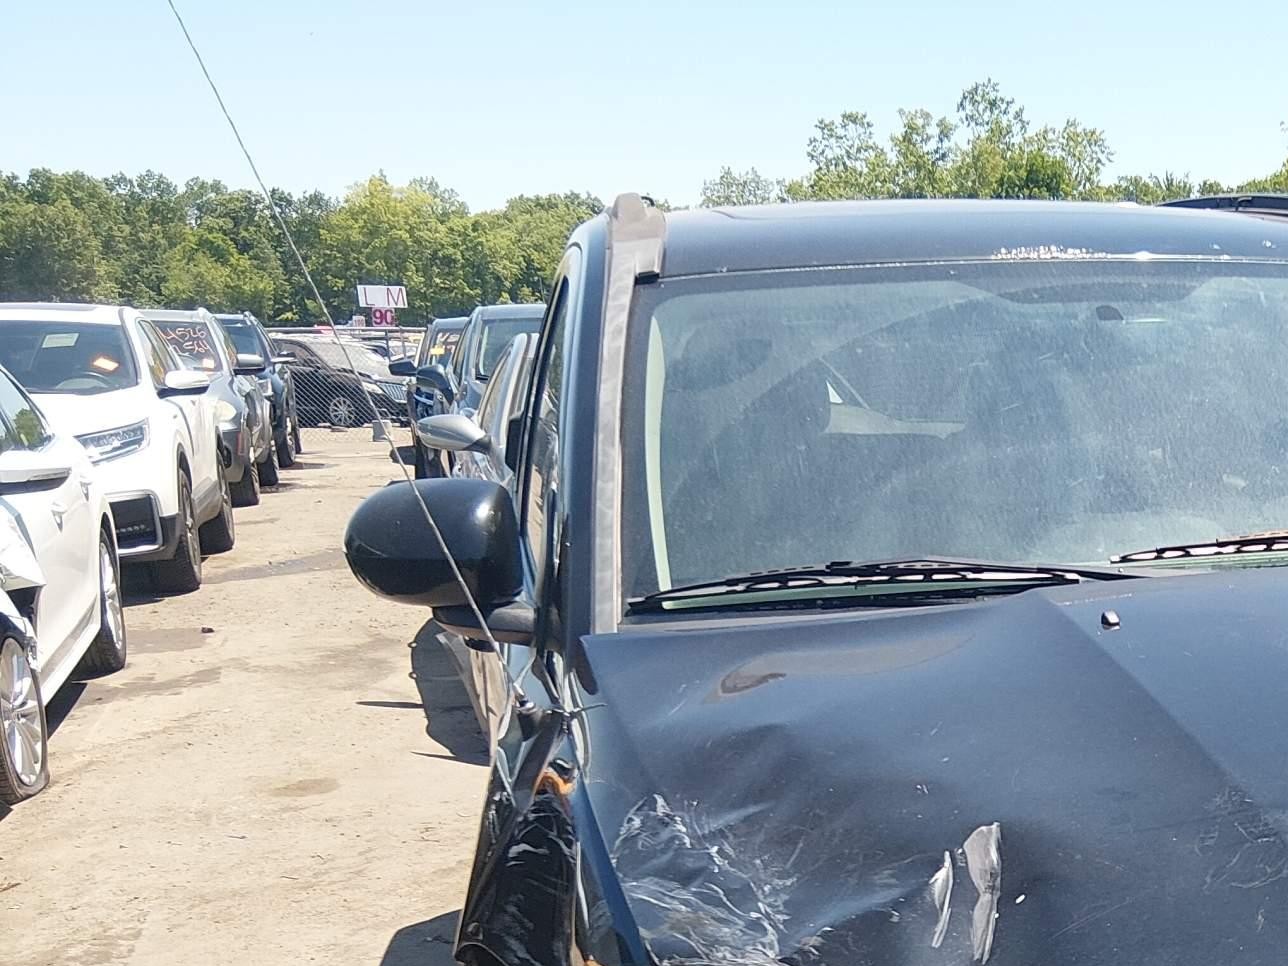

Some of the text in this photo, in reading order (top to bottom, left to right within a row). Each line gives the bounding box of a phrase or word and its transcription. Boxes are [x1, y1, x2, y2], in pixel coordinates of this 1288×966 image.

[363, 287, 406, 306] L M
[372, 308, 395, 326] 90
